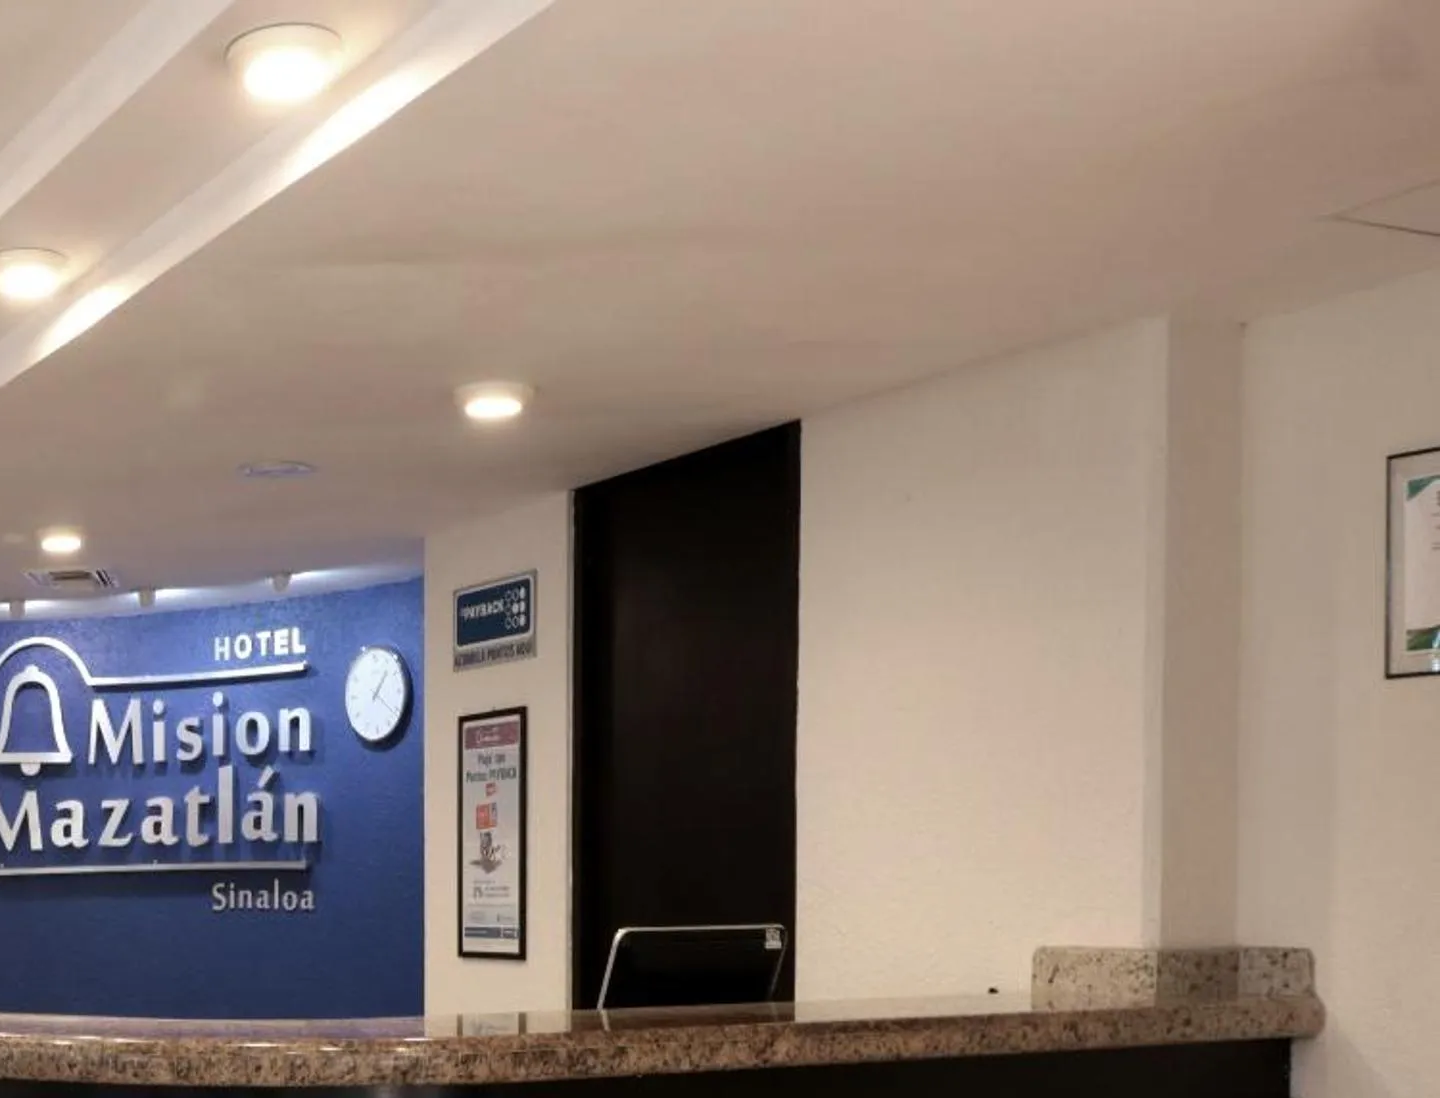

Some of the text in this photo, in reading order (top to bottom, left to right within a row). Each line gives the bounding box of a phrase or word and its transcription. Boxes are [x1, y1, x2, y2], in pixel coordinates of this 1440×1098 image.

[214, 627, 306, 661] HOTEL
[88, 691, 311, 765] Mision
[212, 879, 315, 911] Sinaloa
